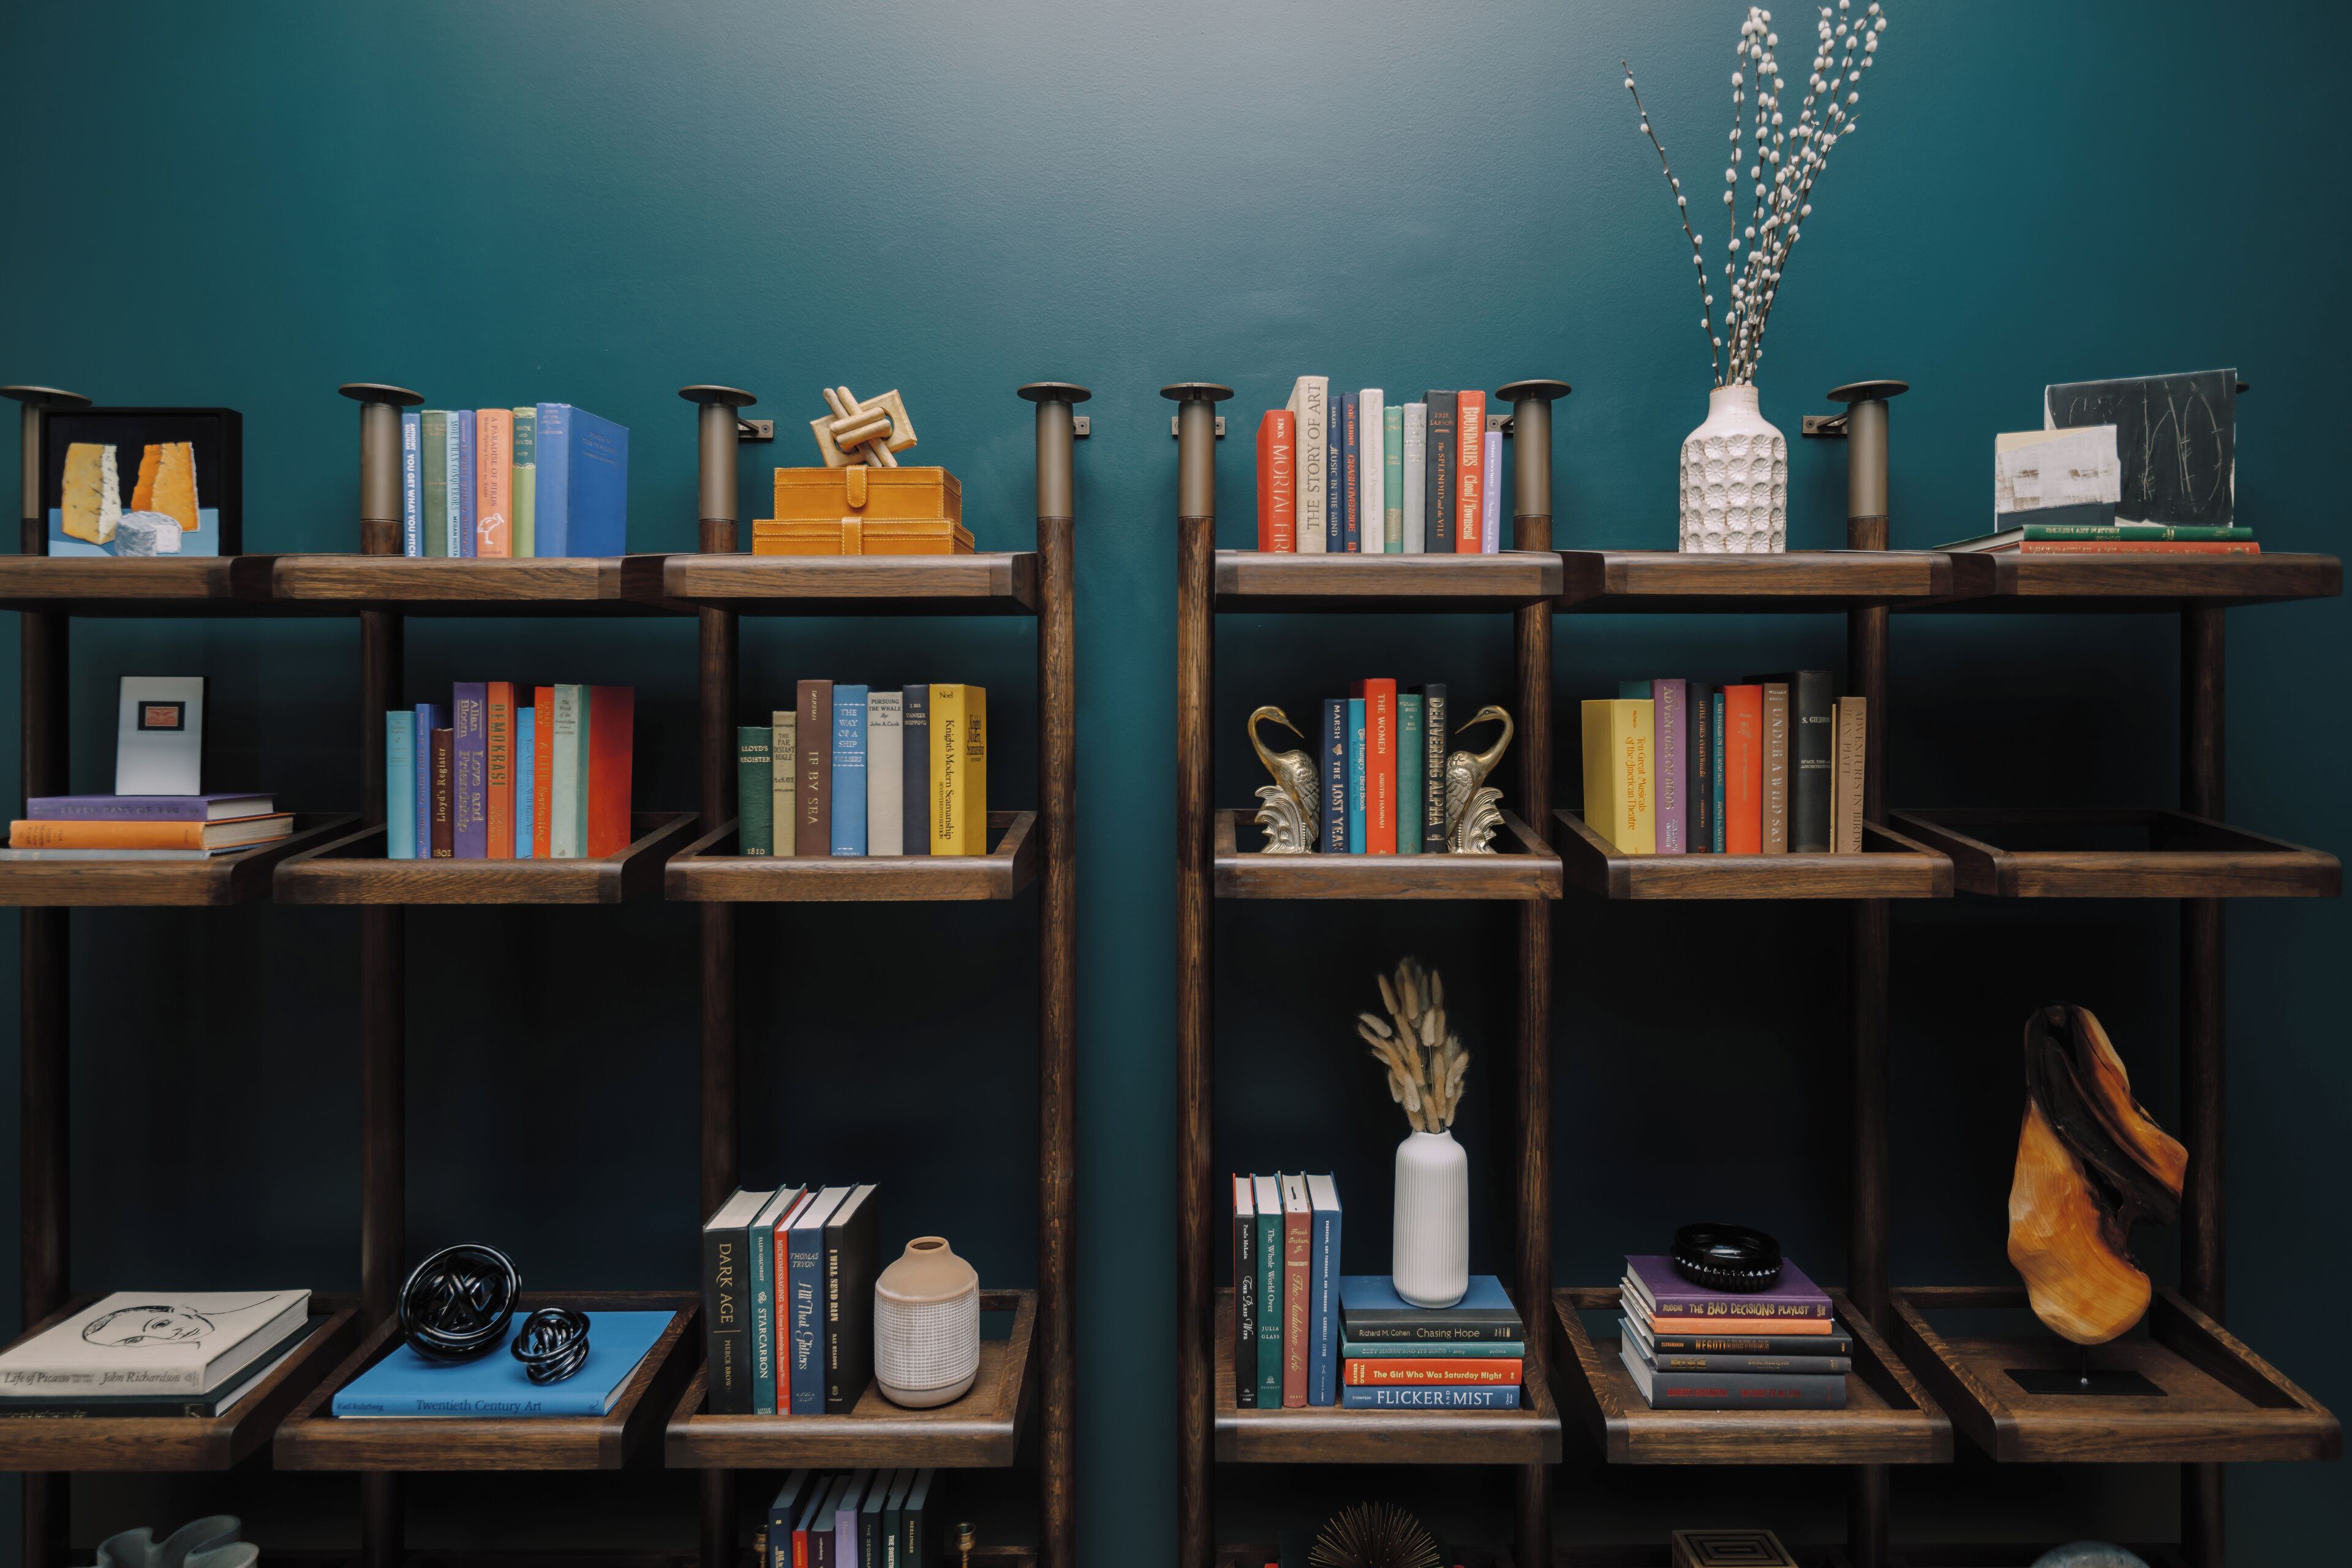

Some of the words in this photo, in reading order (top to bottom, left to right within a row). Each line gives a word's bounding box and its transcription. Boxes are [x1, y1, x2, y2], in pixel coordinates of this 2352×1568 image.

[1307, 383, 1320, 415] ART
[450, 421, 459, 440] MORE
[1307, 418, 1319, 440] OF
[1463, 407, 1480, 466] BOUNDARIES
[450, 443, 459, 462] THAN
[1307, 443, 1319, 492] STORY
[1330, 445, 1338, 476] MUSIC
[451, 464, 459, 510] CONQUERORS
[491, 469, 497, 479] OF
[1273, 446, 1289, 518] MORTAL
[1330, 480, 1337, 489] IN
[407, 489, 416, 513] WHAT
[1307, 500, 1319, 530] THE
[1273, 524, 1289, 552] FIR
[461, 700, 469, 737] Bloom
[470, 700, 479, 731] Allan
[1664, 687, 1675, 756] ADVENTURE
[489, 704, 507, 786] DEMOKRASI
[944, 720, 954, 752] Knight's
[1429, 698, 1444, 777] DELIVERING
[1637, 737, 1646, 752] Ten
[1771, 708, 1783, 757] UNDER
[809, 752, 818, 764] IF
[1626, 747, 1635, 760] the
[1637, 753, 1646, 775] Great
[1853, 710, 1863, 790] ADVENTURES
[437, 748, 447, 785] Register
[472, 751, 483, 786] Love
[539, 755, 549, 780] LIFE
[809, 771, 818, 791] BY
[945, 754, 954, 788] Modern
[1626, 761, 1635, 797] American
[1664, 760, 1674, 775] OF
[1771, 764, 1783, 772] A
[437, 790, 446, 822] Lloyd's
[457, 750, 470, 832] Friendship
[1332, 784, 1343, 813] LOST
[1429, 780, 1444, 826] ALPHA
[1638, 778, 1646, 812] Musicals
[1664, 778, 1675, 810] BIRDS
[1771, 778, 1783, 814] WILD
[1853, 794, 1861, 807] IN
[472, 793, 483, 821] and
[536, 786, 548, 842] Everlasting
[808, 797, 818, 825] SEA
[944, 790, 954, 840] Seamanship
[1627, 799, 1636, 831] Theatre
[1332, 816, 1343, 851] YEAR
[1771, 820, 1783, 844] SKY
[716, 1243, 733, 1288] DARK
[798, 1281, 813, 1300] All
[1292, 1274, 1303, 1297] The
[720, 1293, 733, 1324] AGE
[798, 1301, 813, 1328] That
[1292, 1298, 1303, 1346] Audubon
[1689, 1303, 1704, 1313] THE
[1707, 1302, 1727, 1314] BAD
[1730, 1303, 1775, 1316] DECISIONS
[1778, 1305, 1809, 1314] PLAYLIST
[758, 1308, 768, 1379] STARCARBON
[1417, 1329, 1451, 1339] Chasing
[1455, 1329, 1480, 1338] Hope
[794, 1330, 813, 1370] Glitters
[1291, 1348, 1302, 1372] Ark
[1670, 1358, 1706, 1369] RISE
[4, 1371, 24, 1385] Life
[26, 1371, 37, 1385] of
[37, 1372, 70, 1382] Picasso
[100, 1371, 124, 1385] John
[126, 1371, 180, 1382] Richardson
[1444, 1371, 1478, 1380] Saturday
[417, 1400, 471, 1411] Twentieth
[475, 1400, 521, 1414] Century
[524, 1400, 541, 1411] Art
[1377, 1390, 1444, 1405] FLICKER
[1453, 1392, 1493, 1405] MIST
